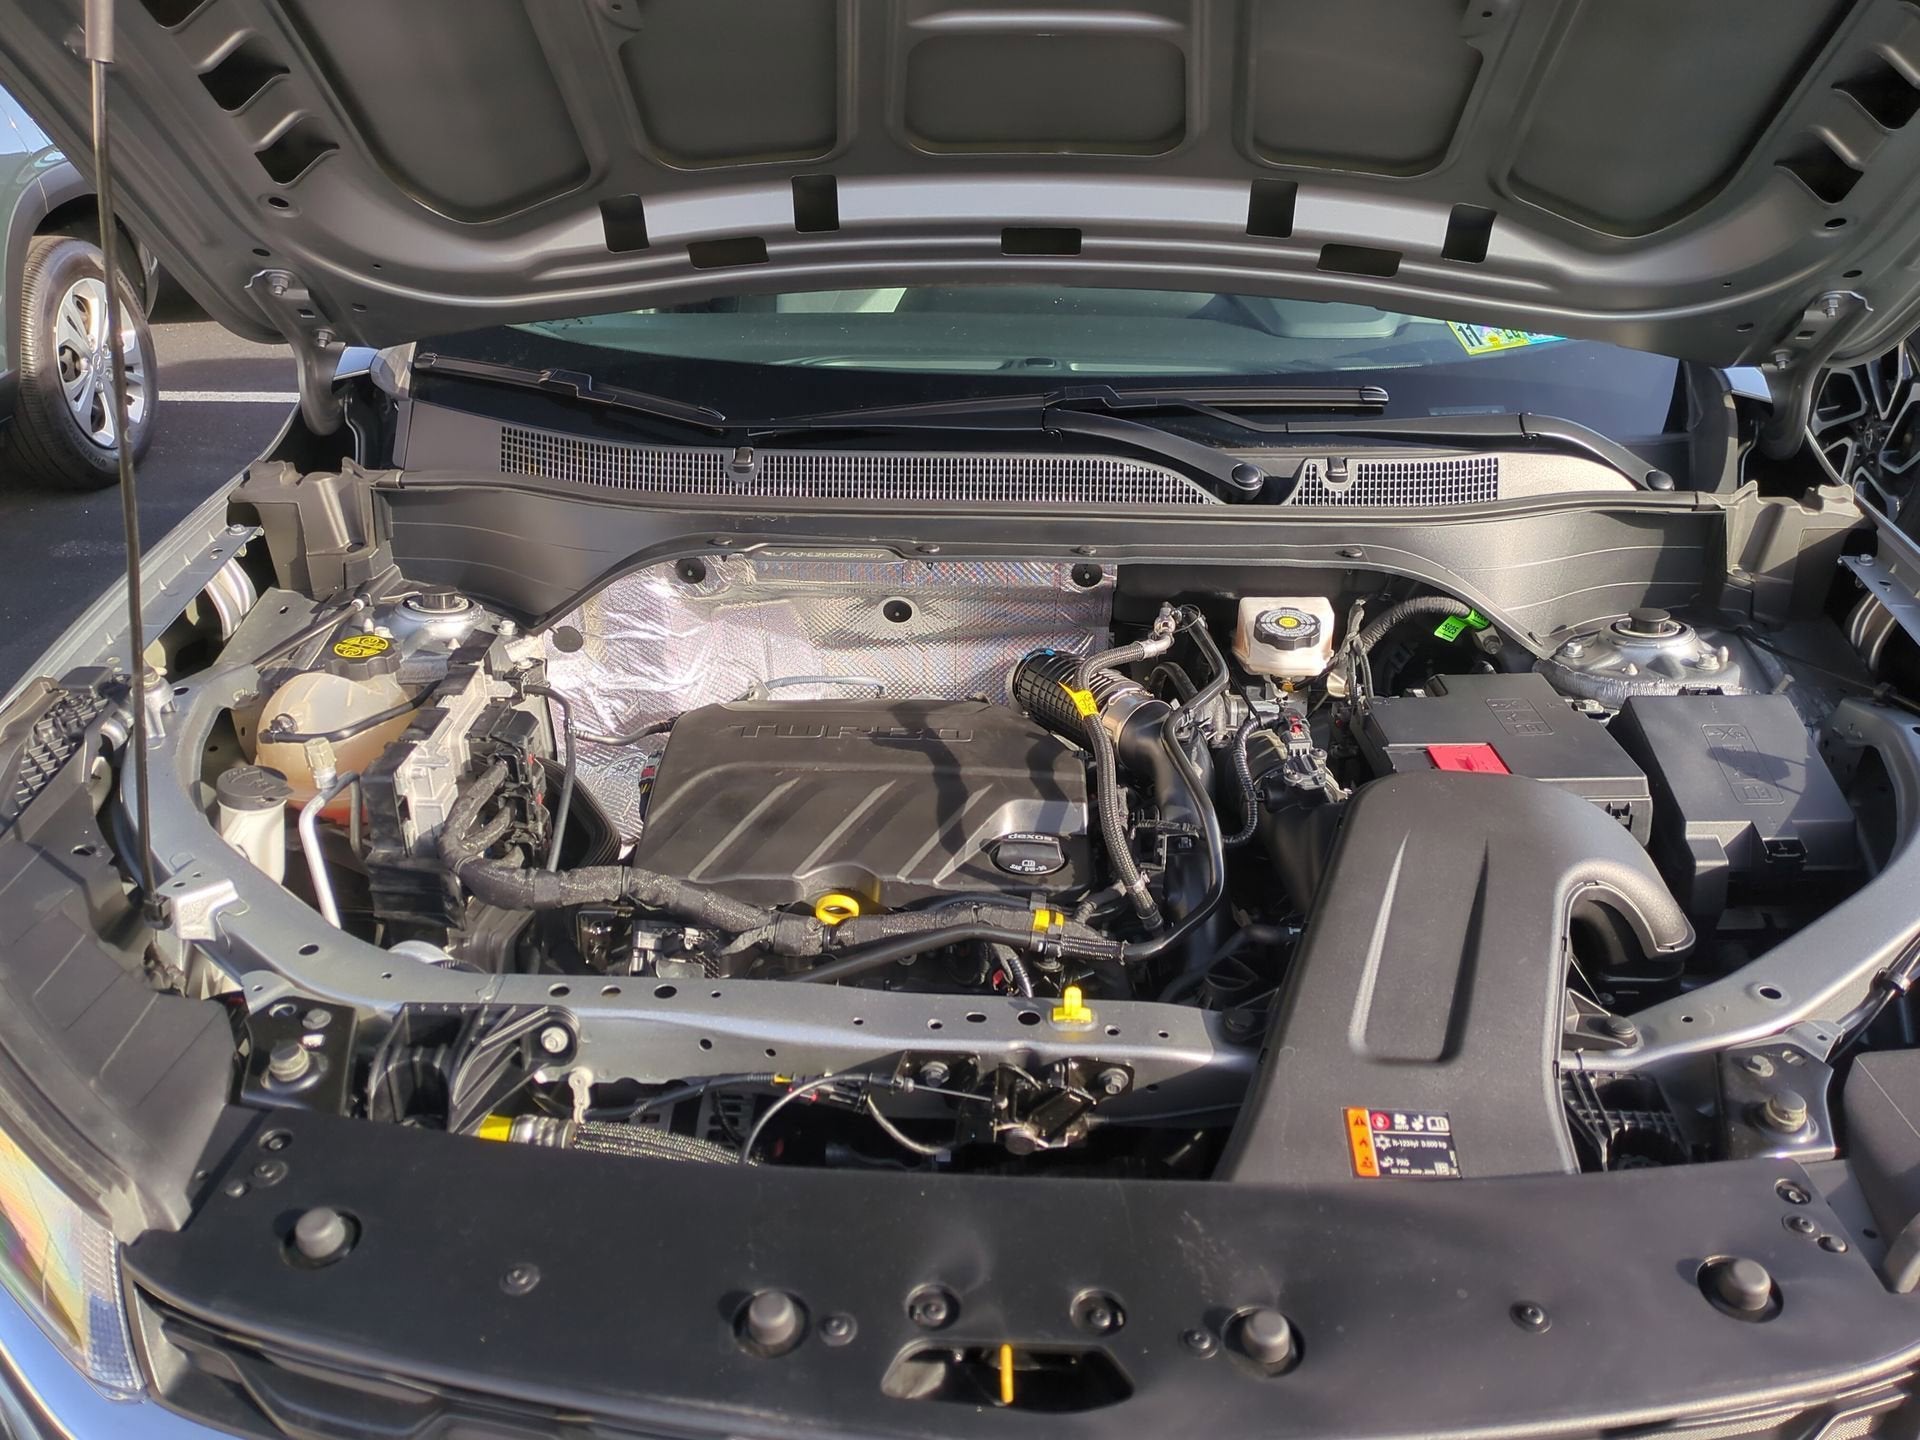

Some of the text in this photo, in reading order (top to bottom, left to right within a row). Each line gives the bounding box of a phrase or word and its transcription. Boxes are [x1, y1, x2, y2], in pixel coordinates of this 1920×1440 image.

[1457, 324, 1483, 347] 11
[728, 723, 975, 743] TURBO
[1008, 833, 1052, 841] dexos
